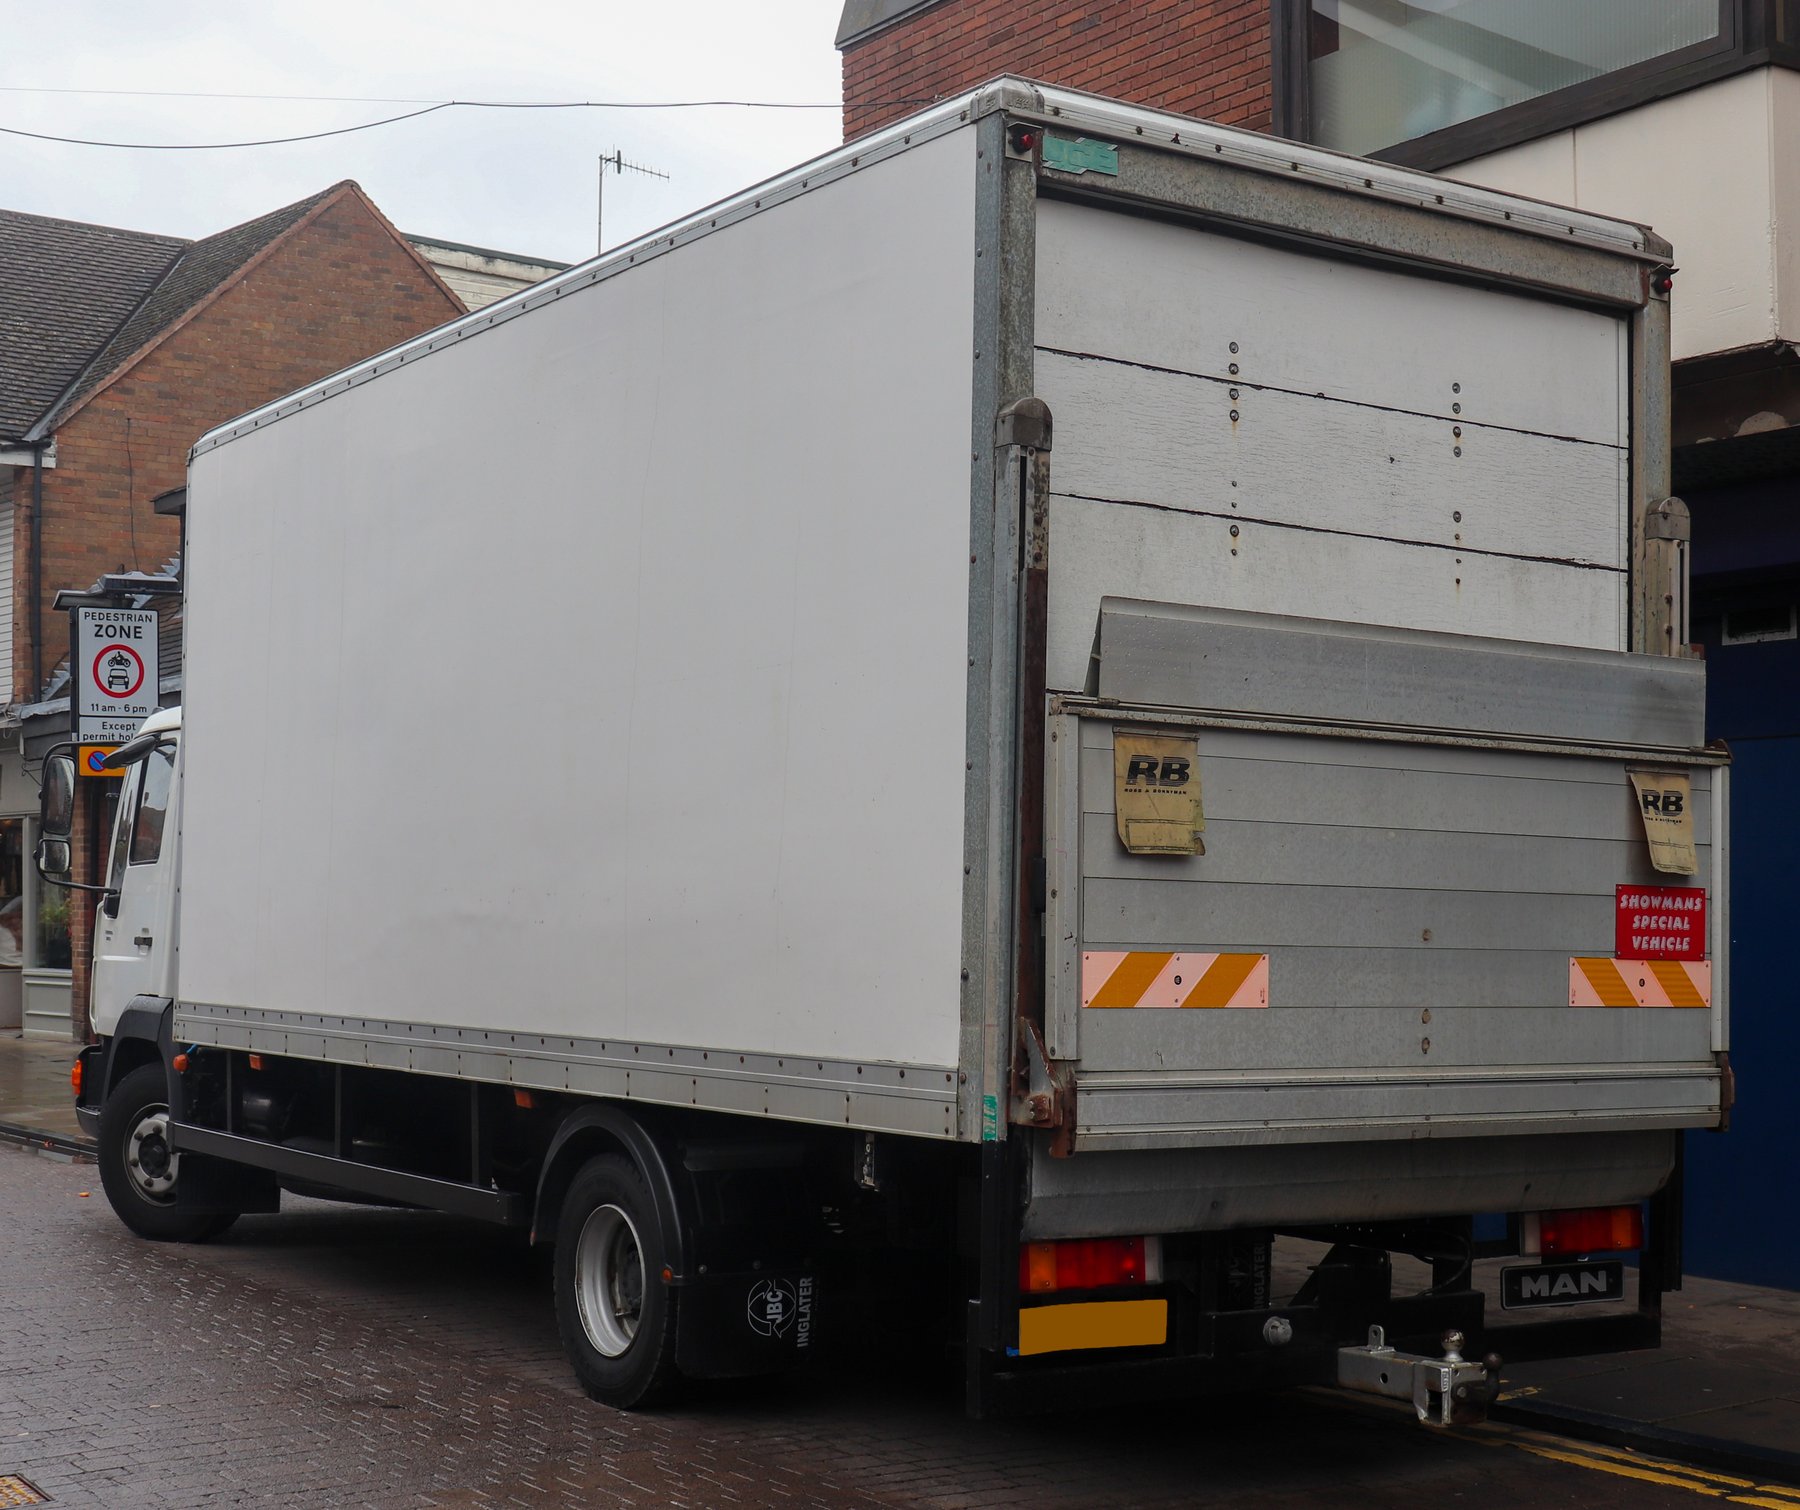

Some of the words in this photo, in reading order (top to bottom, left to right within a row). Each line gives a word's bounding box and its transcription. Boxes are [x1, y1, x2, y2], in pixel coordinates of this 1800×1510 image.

[84, 611, 153, 623] PEDESTRIAN
[94, 624, 143, 639] ZONE
[102, 721, 137, 732] Except
[83, 732, 116, 742] permit
[118, 732, 134, 742] hol
[1126, 754, 1190, 787] RB
[1641, 788, 1684, 817] RB
[1620, 894, 1702, 912] SHOWMANS
[1632, 915, 1690, 931] SPECIAL
[1632, 936, 1690, 951] VEHICLE
[1521, 1270, 1607, 1298] MAN
[797, 1276, 813, 1347] INGLATER
